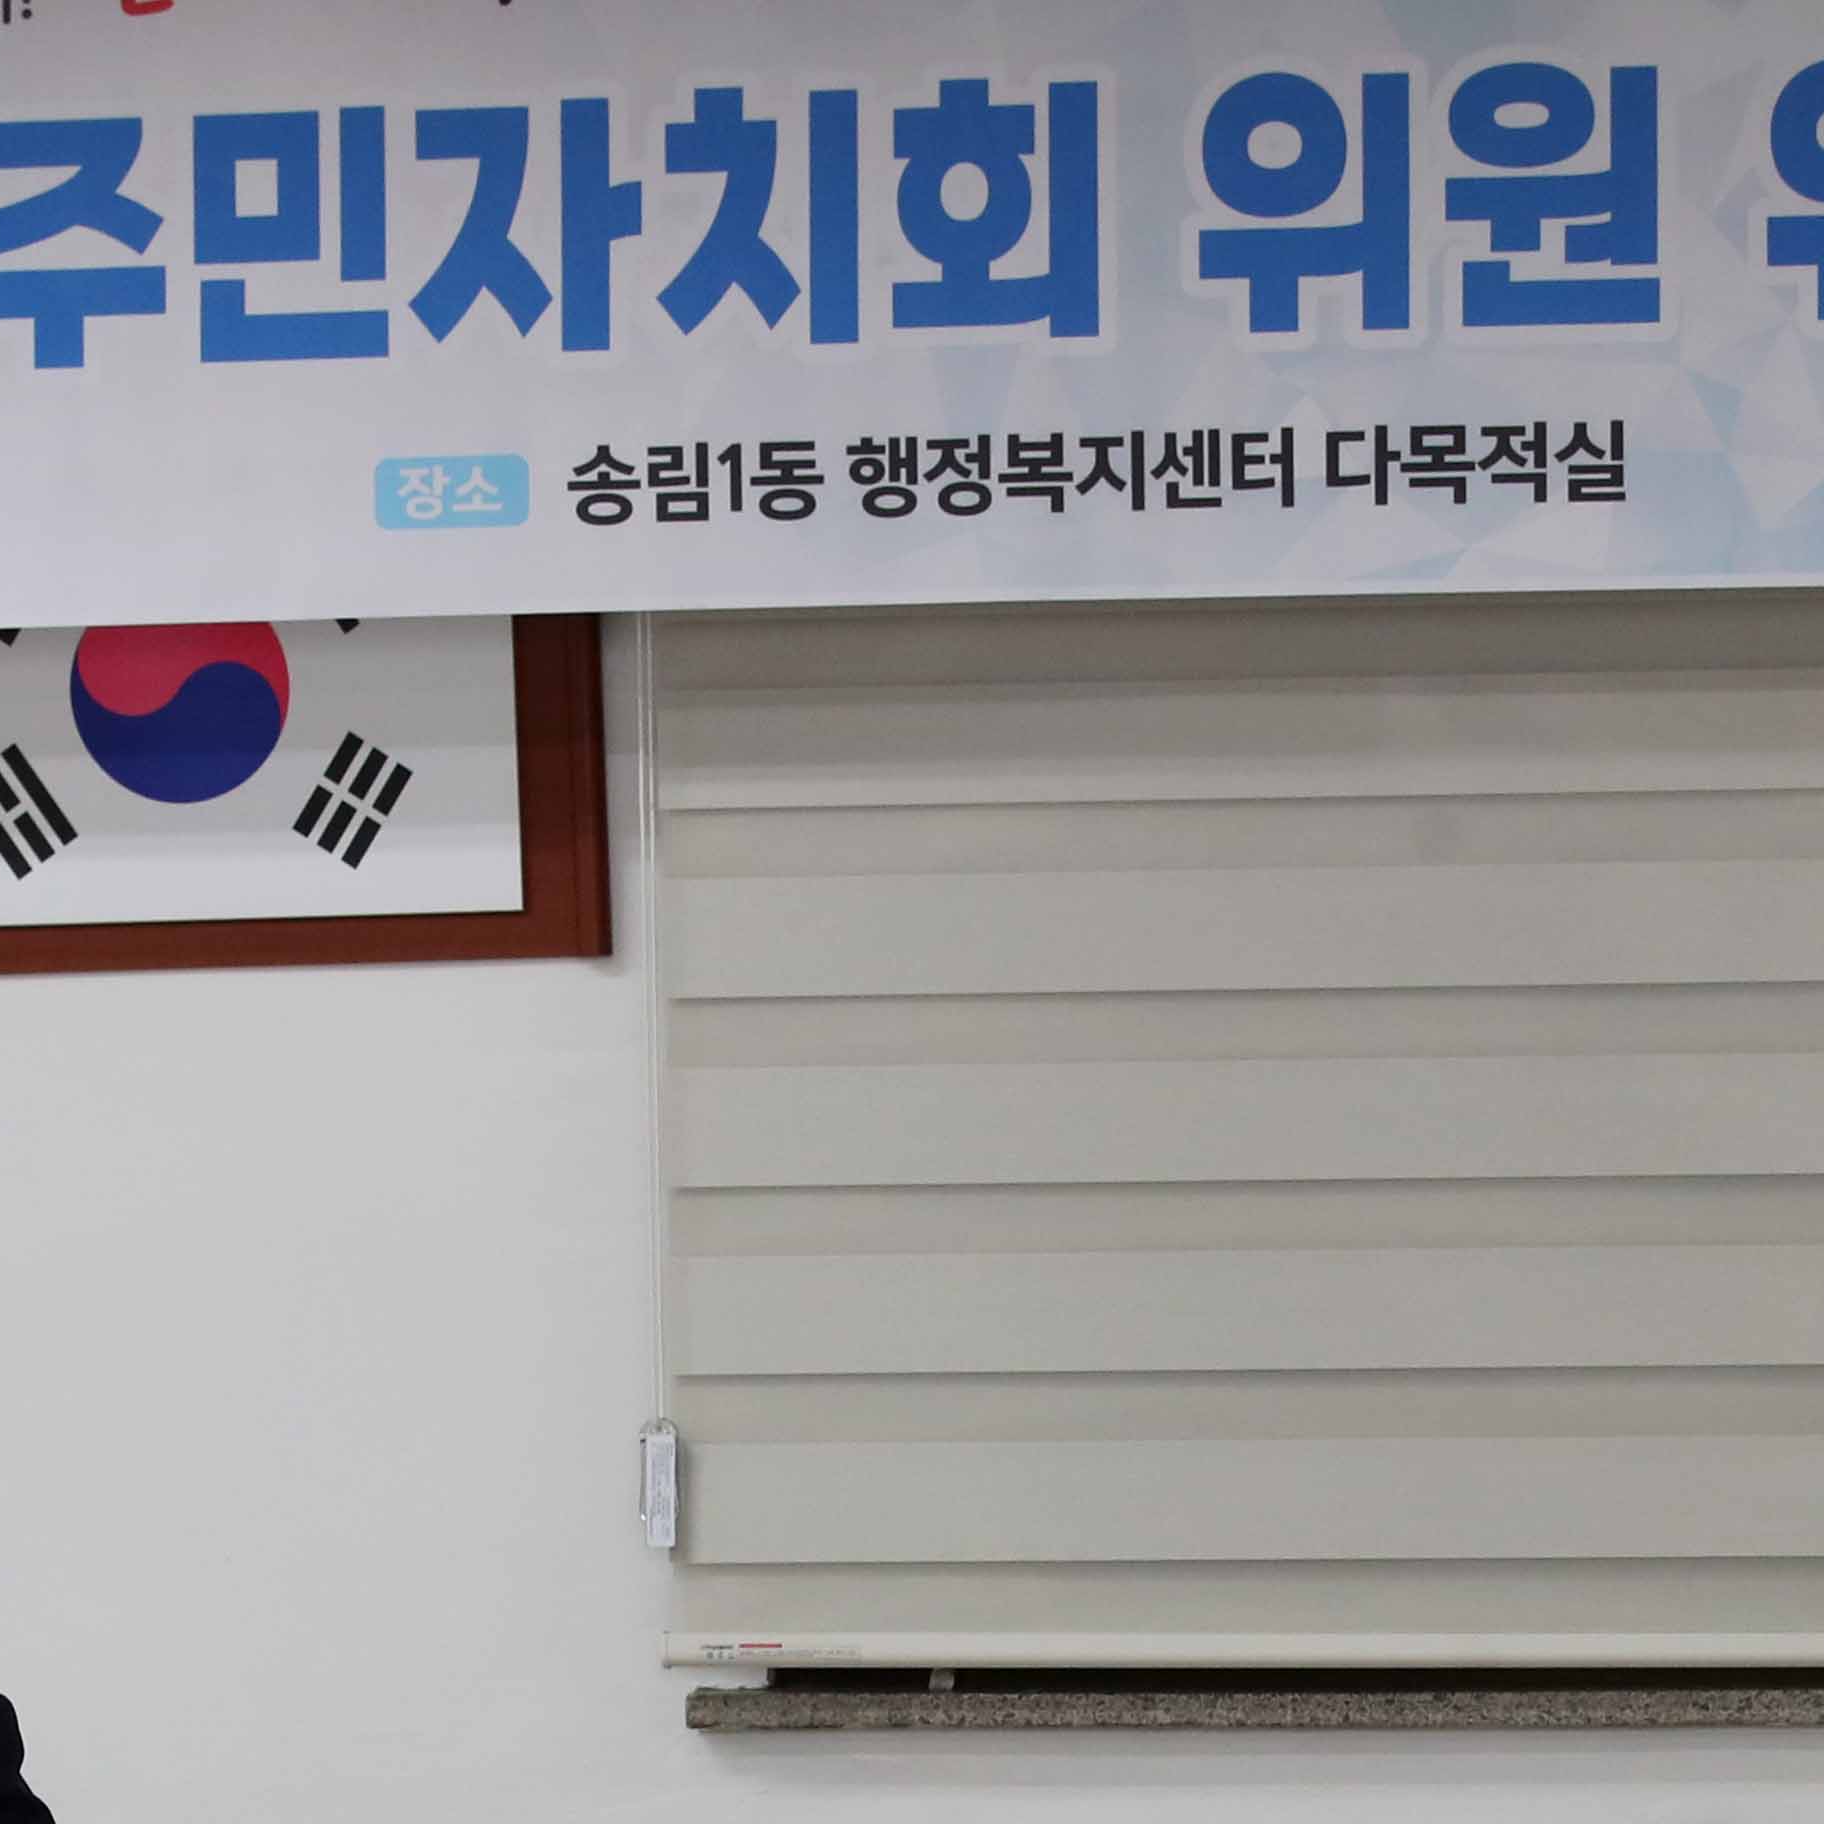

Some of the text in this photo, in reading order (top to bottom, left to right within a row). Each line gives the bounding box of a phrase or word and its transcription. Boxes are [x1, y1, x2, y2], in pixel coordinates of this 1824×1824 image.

[1198, 62, 1662, 335] 위원
[396, 463, 507, 521] 장소
[567, 419, 1628, 526] 송림1동 행정복지센터 다목적실
